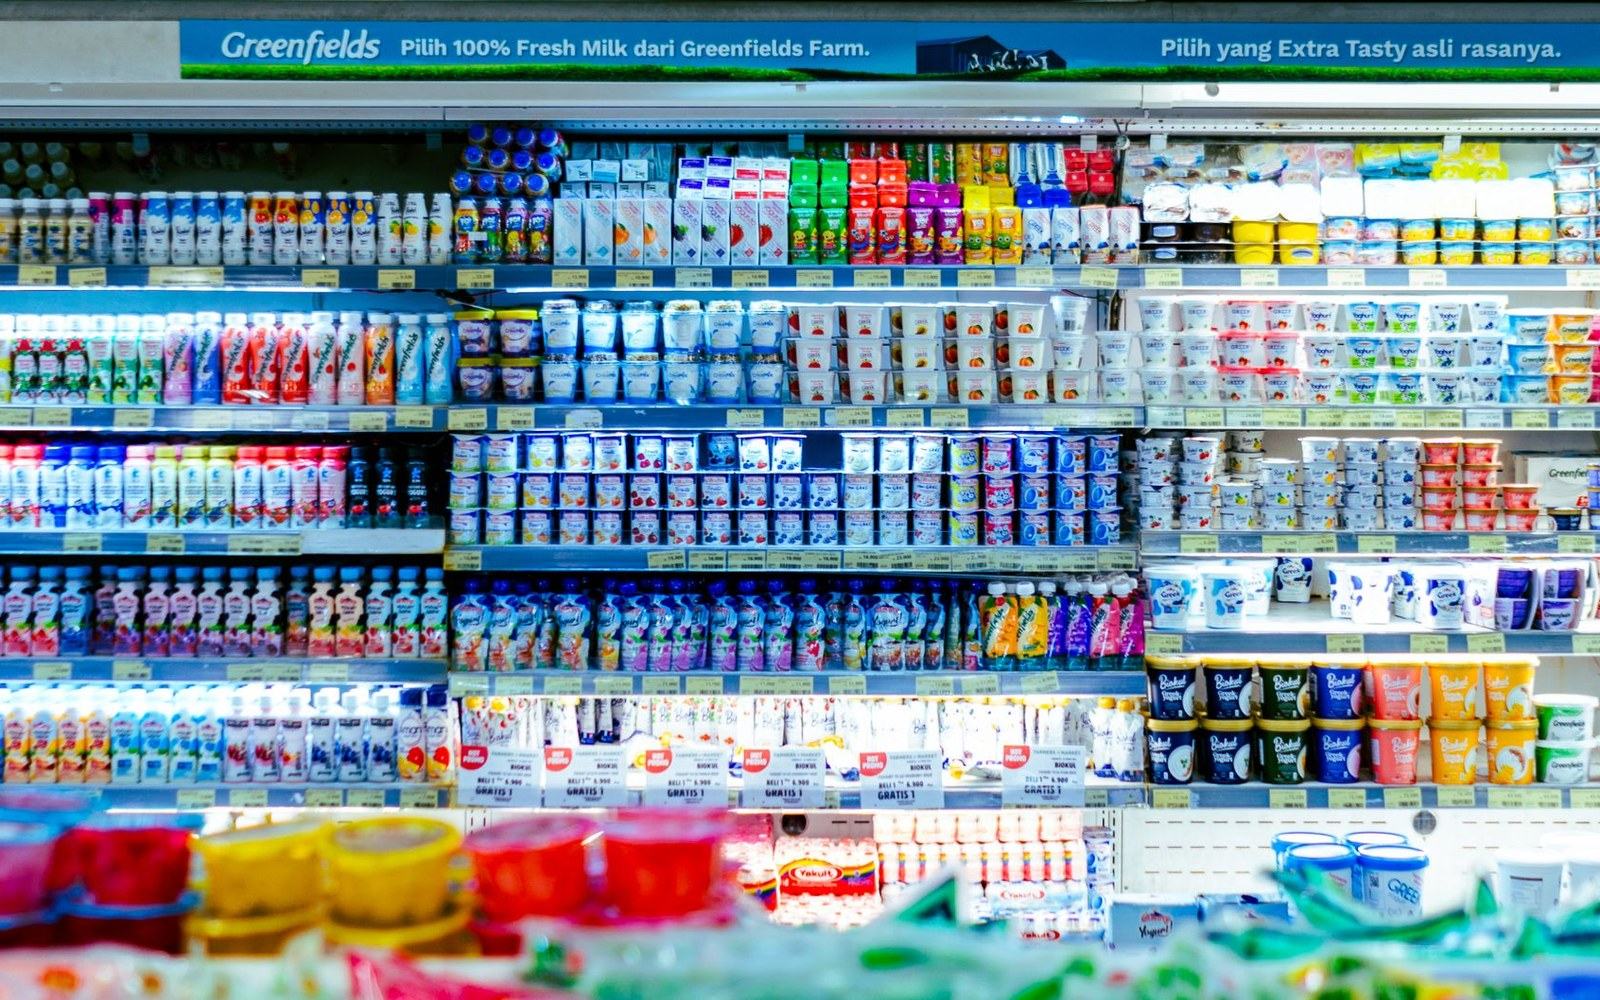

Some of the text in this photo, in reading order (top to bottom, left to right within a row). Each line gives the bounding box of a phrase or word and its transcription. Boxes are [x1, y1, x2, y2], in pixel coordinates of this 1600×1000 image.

[221, 28, 380, 66] Greenfields
[401, 39, 870, 58] Pilih 100% Fresh Milk dari Greenfields Farm.
[1161, 38, 1562, 62] Pilih yang Extra Tasty asli rasanya.
[475, 786, 506, 796] GRATIS
[566, 787, 597, 796] GRATIS
[667, 788, 698, 798] GRATIS
[765, 788, 796, 798] GRATIS
[1024, 785, 1055, 795] GRATIS
[877, 790, 909, 801] GRATIS
